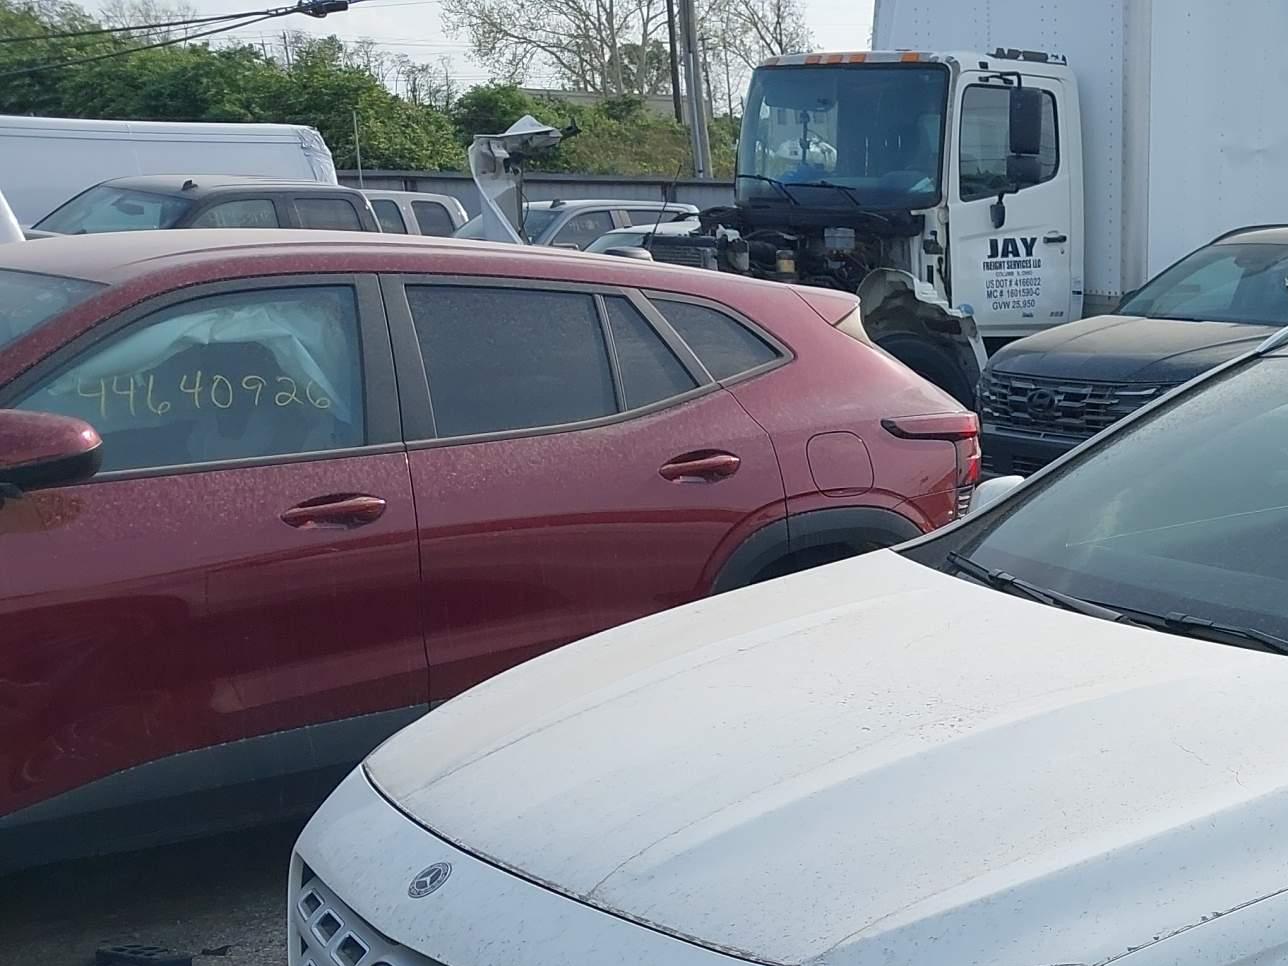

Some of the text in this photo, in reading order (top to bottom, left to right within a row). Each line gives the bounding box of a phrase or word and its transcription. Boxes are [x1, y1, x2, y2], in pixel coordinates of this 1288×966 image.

[987, 237, 1037, 258] JAY
[983, 260, 1005, 271] FREIGHT
[1007, 259, 1031, 270] SERVICES
[986, 279, 994, 289] US
[995, 278, 1008, 288] DOT
[987, 289, 998, 299] MC
[992, 301, 1010, 310] GVW
[78, 370, 331, 415] 44640926
